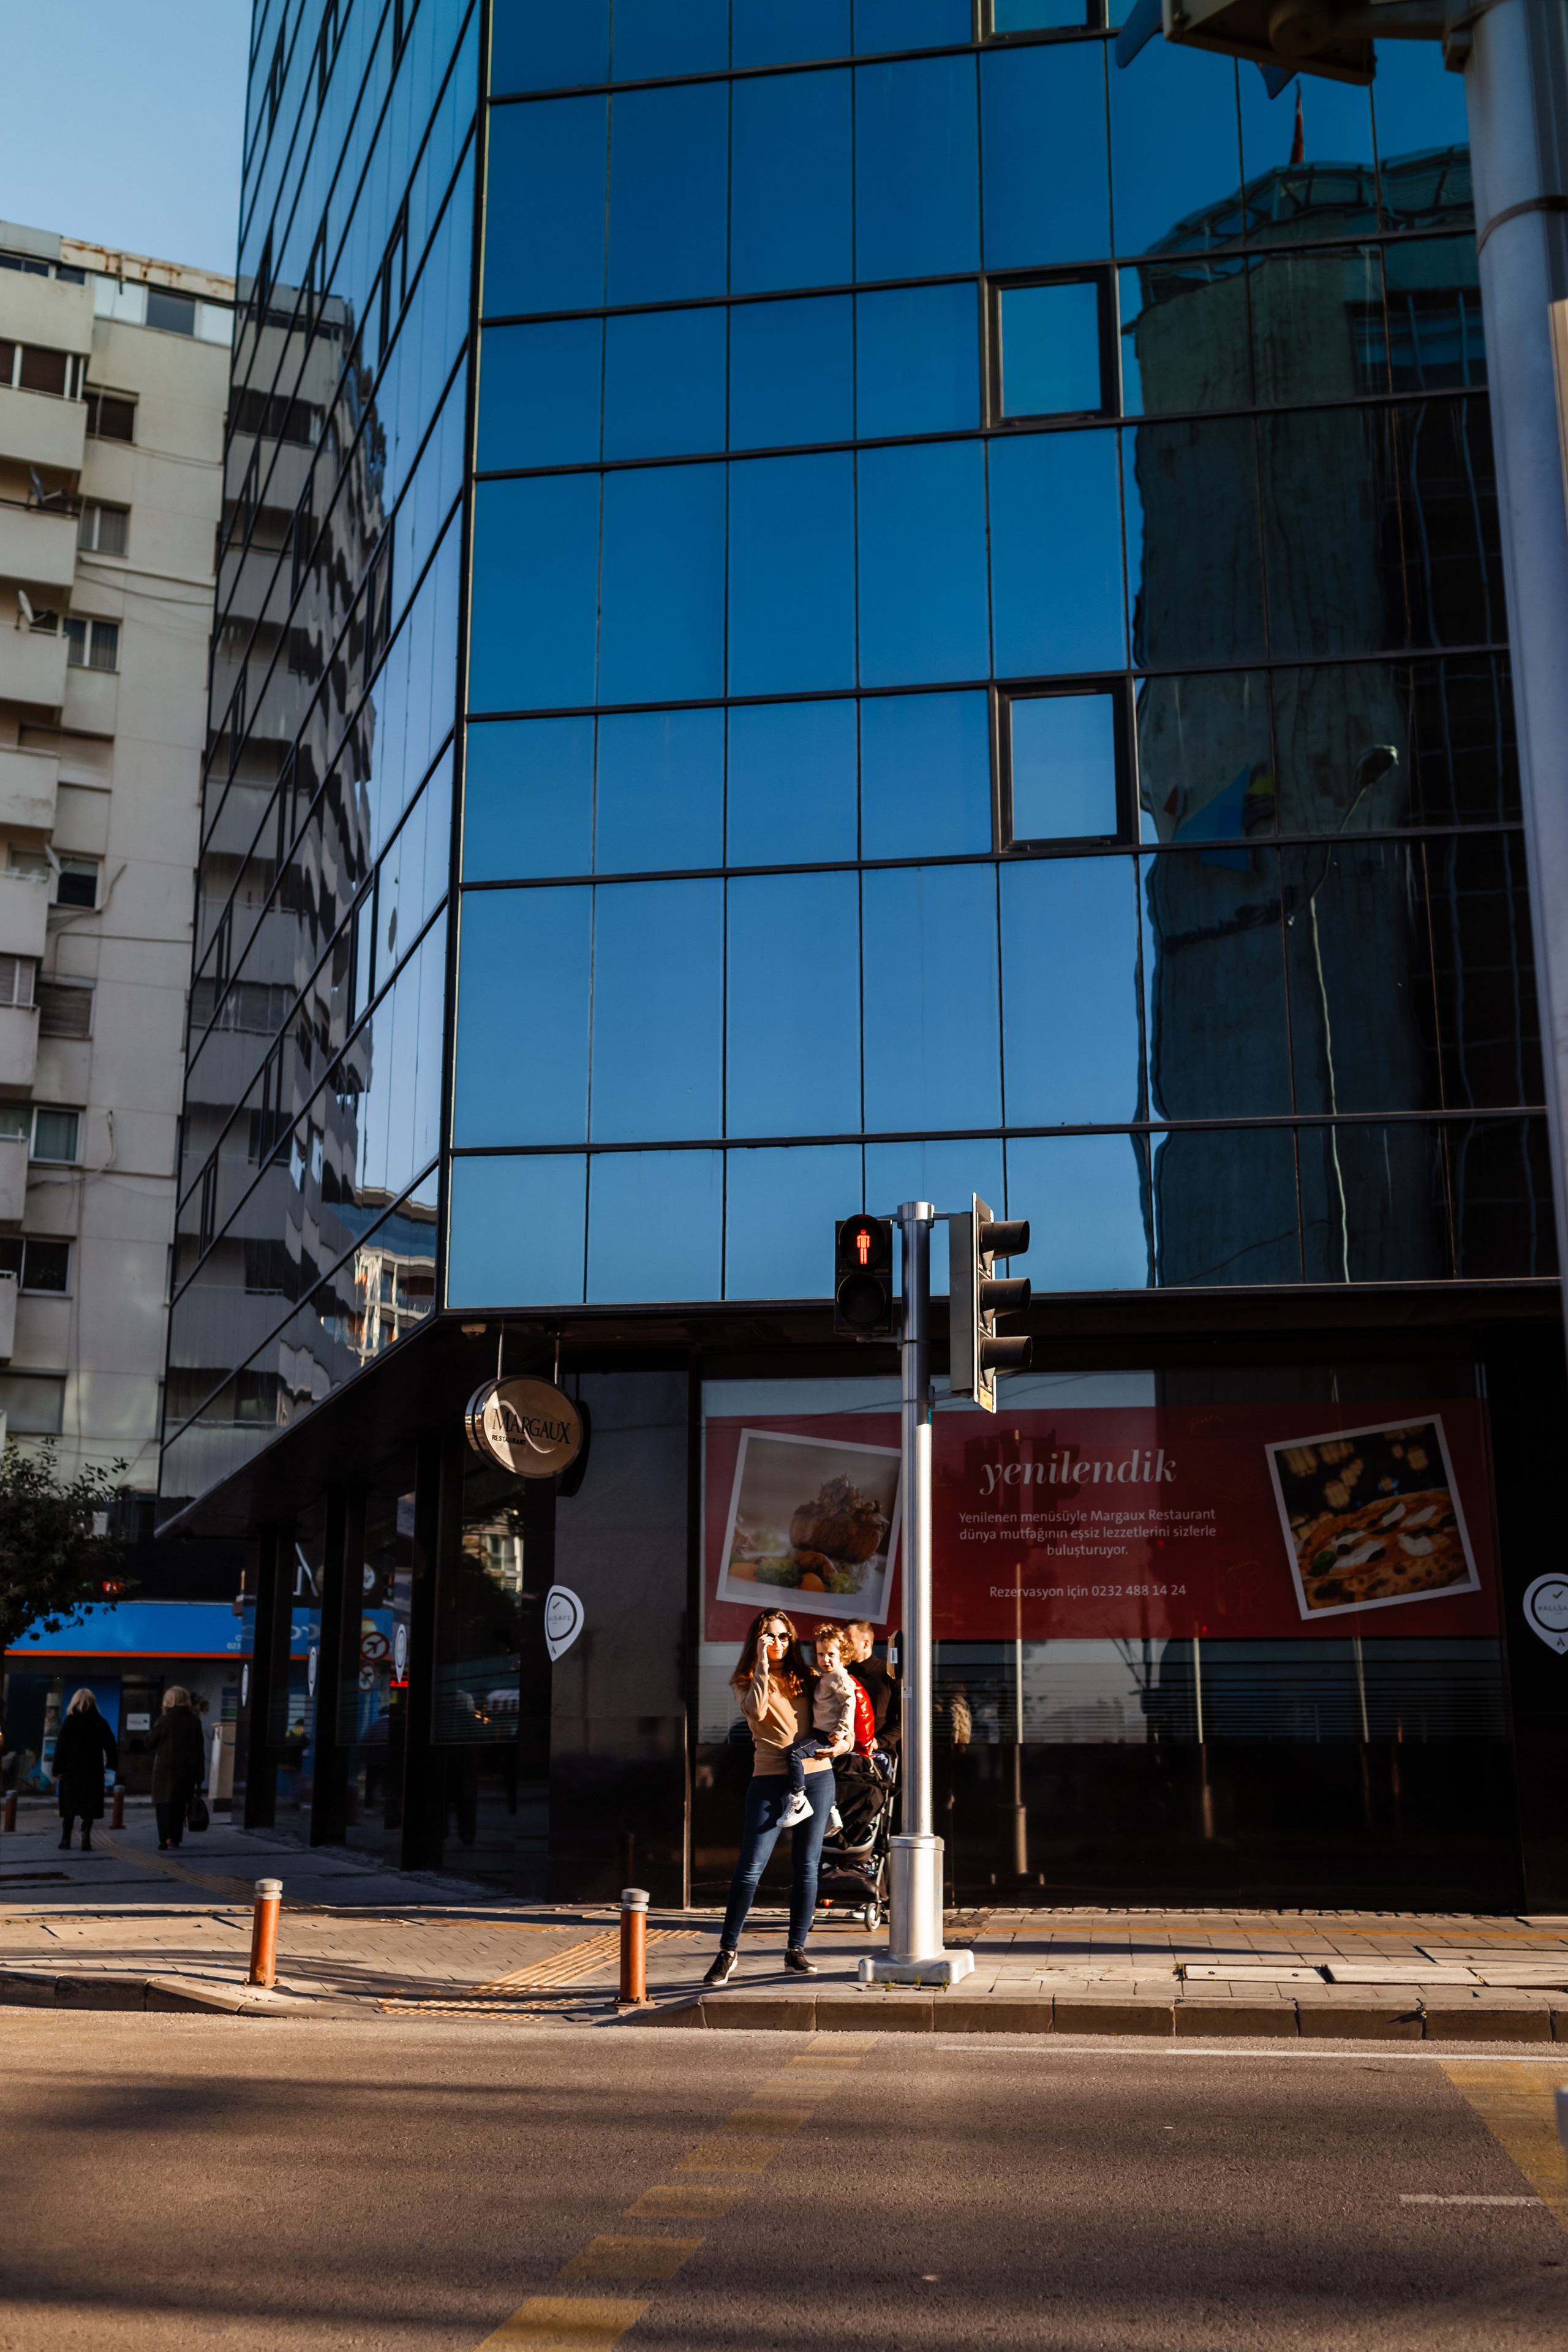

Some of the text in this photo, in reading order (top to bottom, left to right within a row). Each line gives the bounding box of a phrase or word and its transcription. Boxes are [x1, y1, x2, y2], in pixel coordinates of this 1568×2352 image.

[492, 1408, 571, 1444] MARGAUX
[492, 1435, 526, 1446] RESTAURANT
[980, 1449, 1175, 1494] yenilendik
[959, 1509, 1215, 1525] Yenilenen menüsüyle Margaux Restaurant
[960, 1525, 1216, 1542] dünya mutfağının eşsiz lezzetlerini sizlerle
[1047, 1544, 1128, 1558] buluşturuyor.
[990, 1585, 1186, 1600] Rezervasyon için 0232 488 14 24
